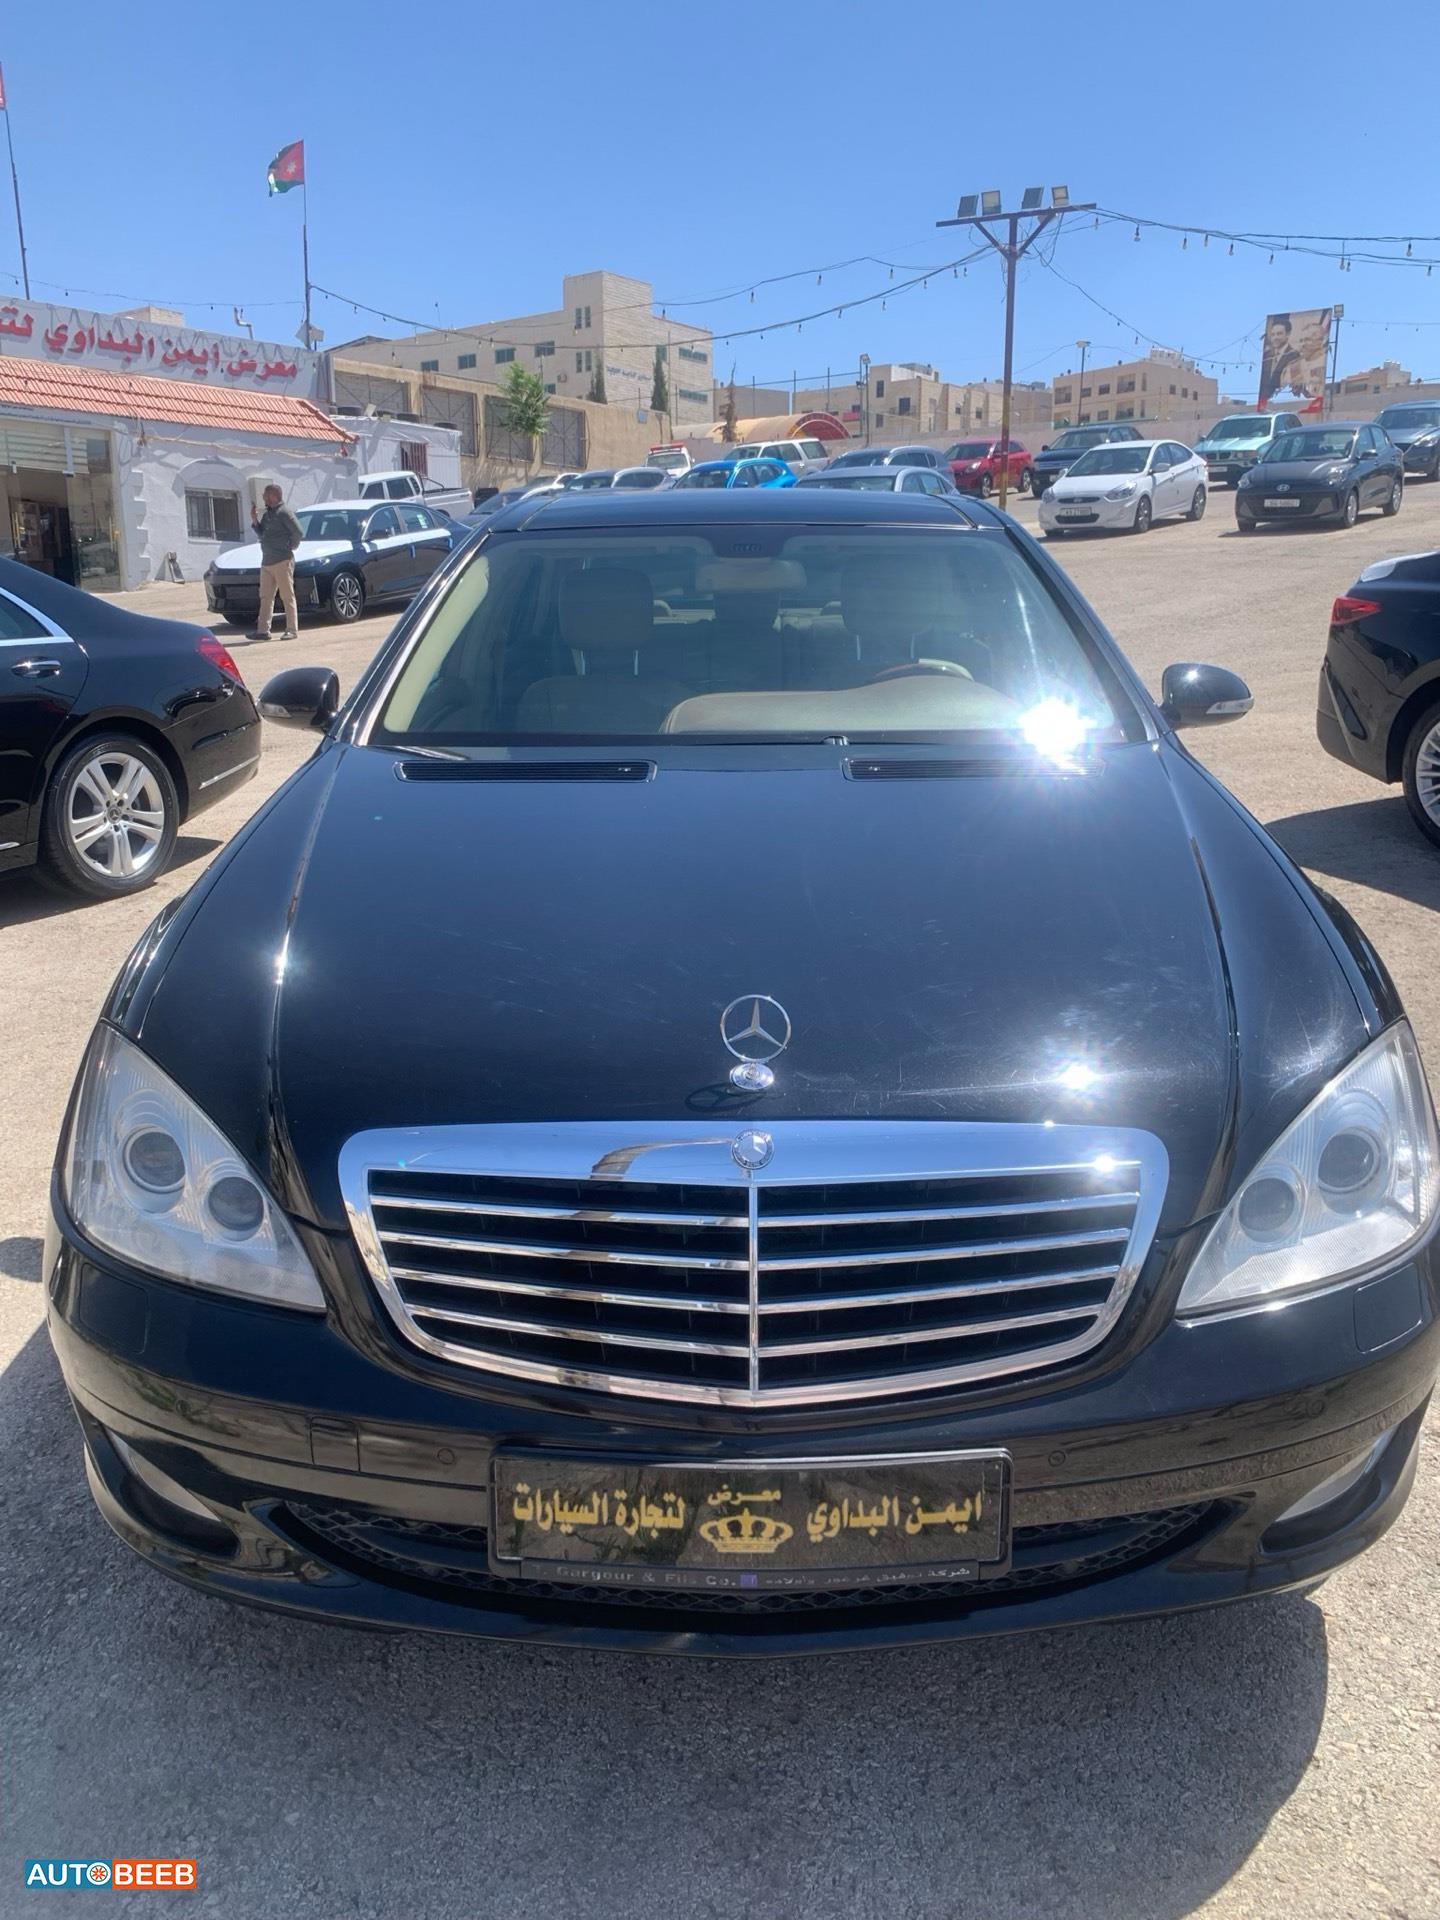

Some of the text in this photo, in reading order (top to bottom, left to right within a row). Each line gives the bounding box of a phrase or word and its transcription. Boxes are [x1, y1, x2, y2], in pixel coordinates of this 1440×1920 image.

[0, 306, 298, 381] معرض ايمن البداوي لت
[513, 1482, 982, 1543] ايمن البداوي لتجارة السيارات
[707, 1483, 782, 1506] معرض
[556, 1566, 635, 1581] Gargour
[642, 1572, 656, 1583] &
[705, 1575, 737, 1586] Co.
